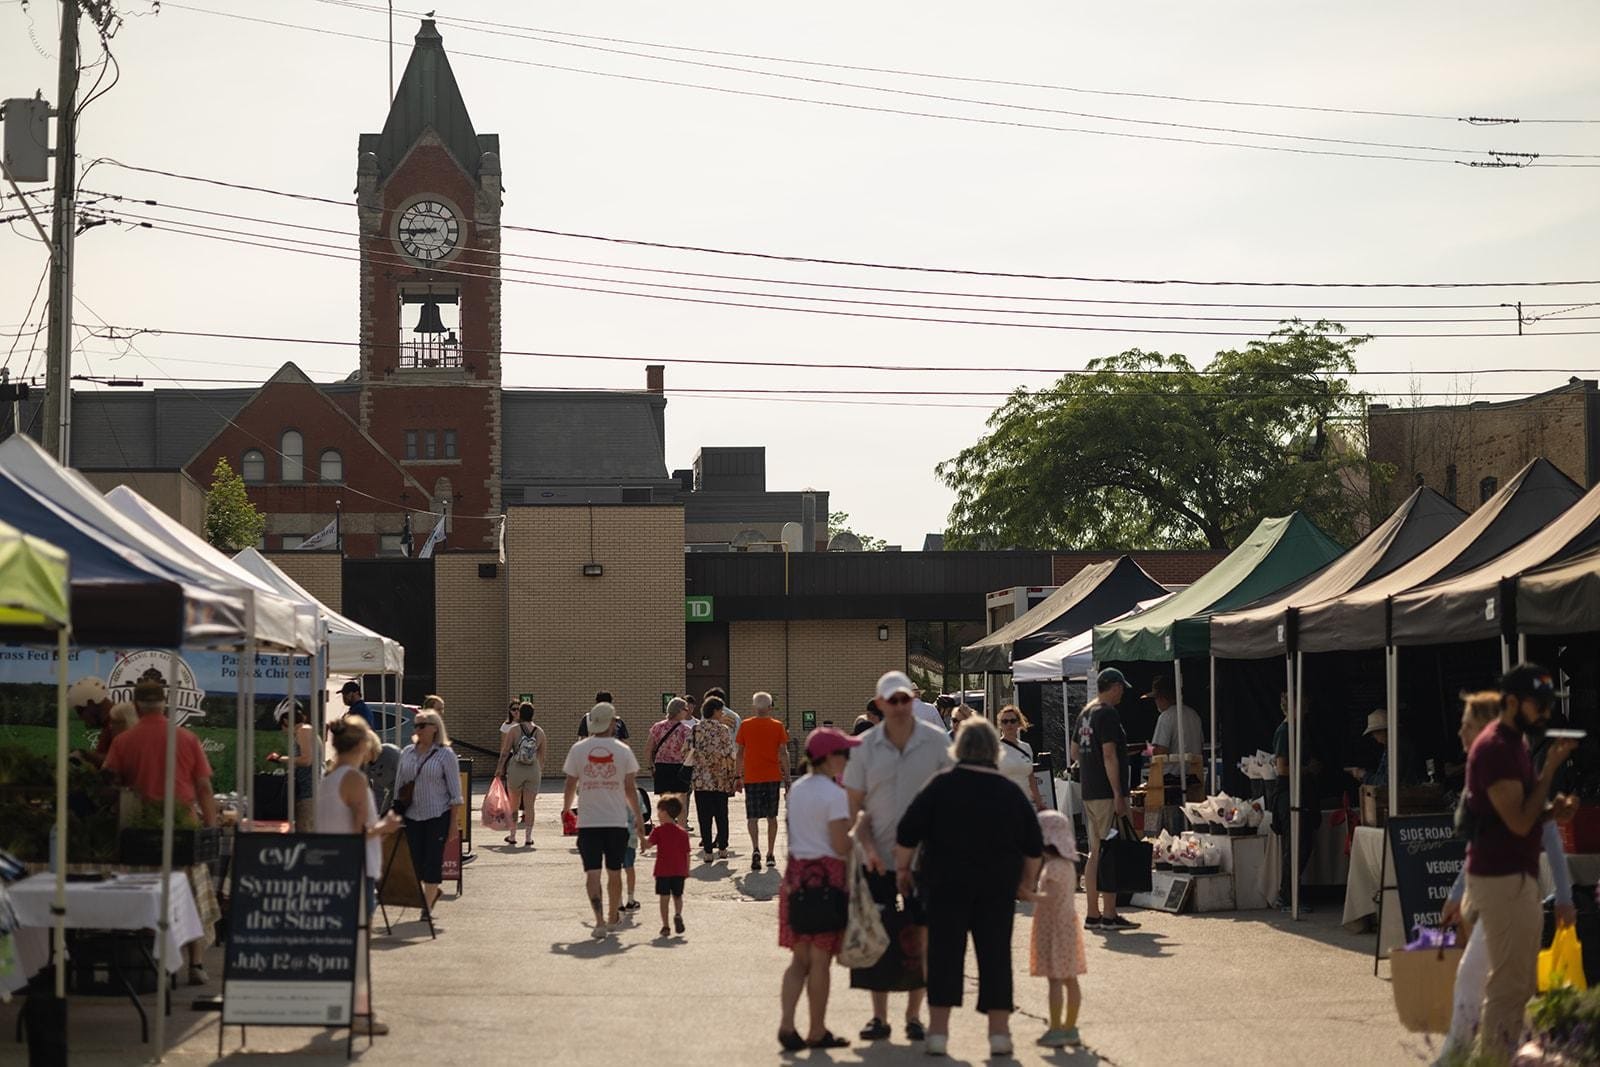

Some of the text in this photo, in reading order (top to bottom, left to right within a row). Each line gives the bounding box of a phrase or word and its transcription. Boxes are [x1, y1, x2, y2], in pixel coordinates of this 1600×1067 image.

[687, 600, 711, 616] TD
[239, 875, 355, 898] Symphony
[262, 893, 330, 912] under
[246, 910, 342, 930] the Stars
[232, 952, 267, 972] July
[272, 953, 290, 970] 12
[307, 953, 349, 974] 8pm
